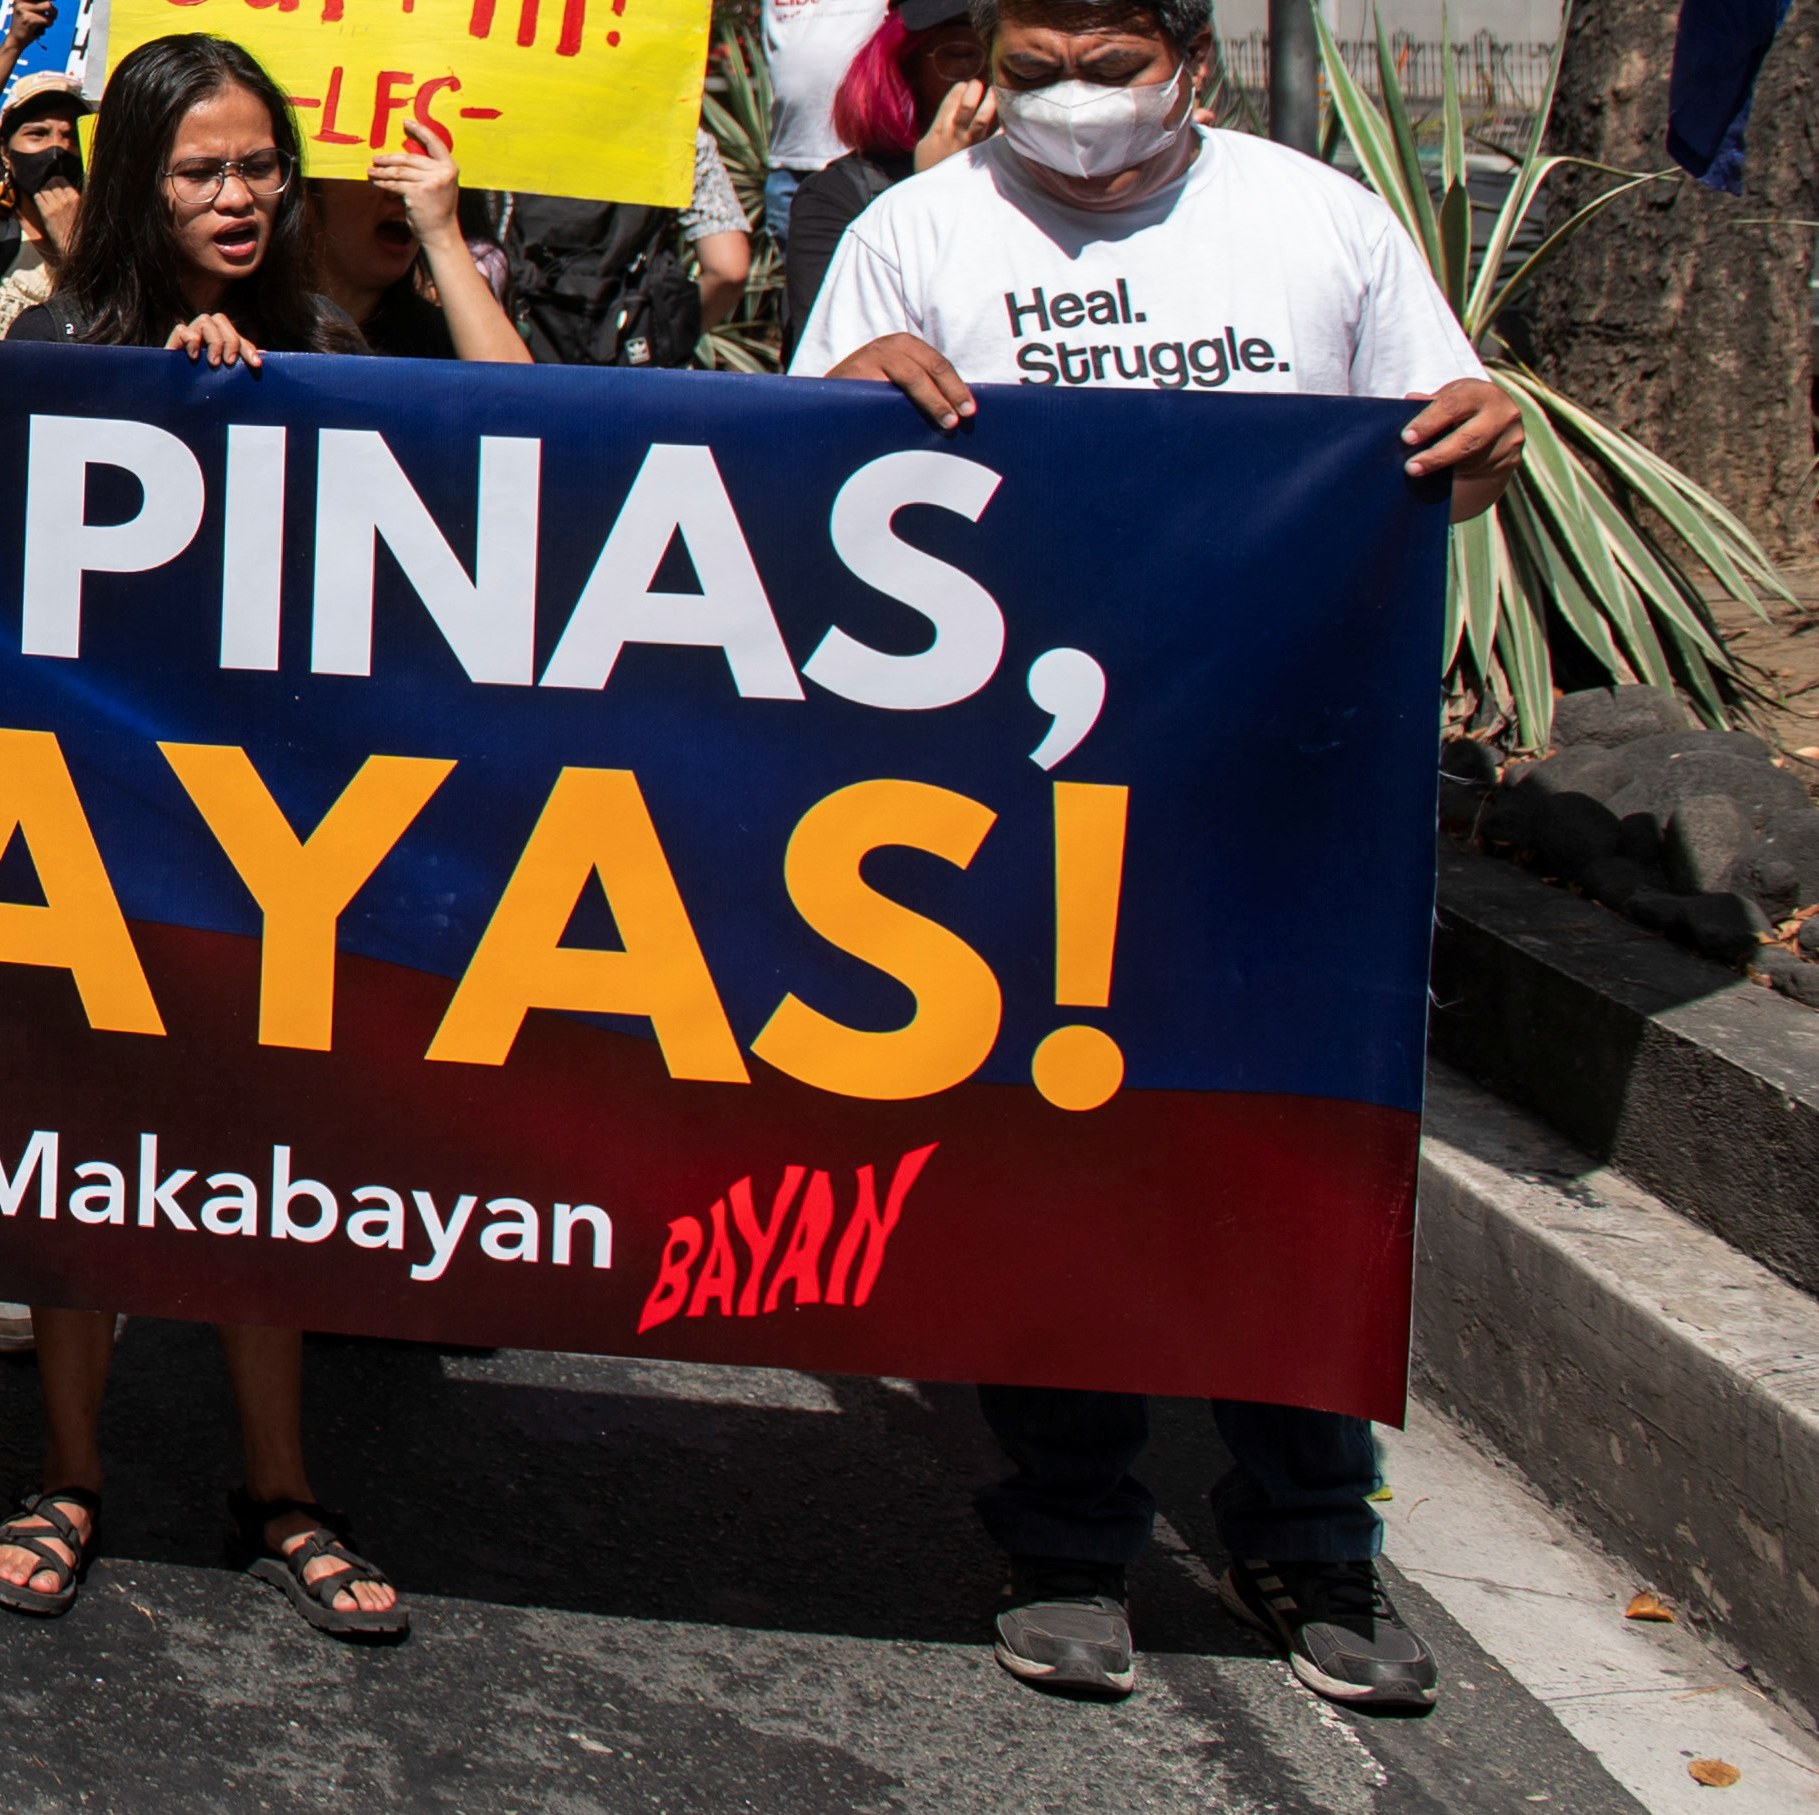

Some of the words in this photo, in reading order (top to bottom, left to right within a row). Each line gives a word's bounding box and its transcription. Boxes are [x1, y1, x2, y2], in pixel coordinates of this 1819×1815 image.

[1005, 278, 1148, 338] Heal.
[1016, 325, 1291, 389] Struggle.
[21, 414, 1108, 770] PINAS,
[636, 1140, 940, 1335] BAYAN
